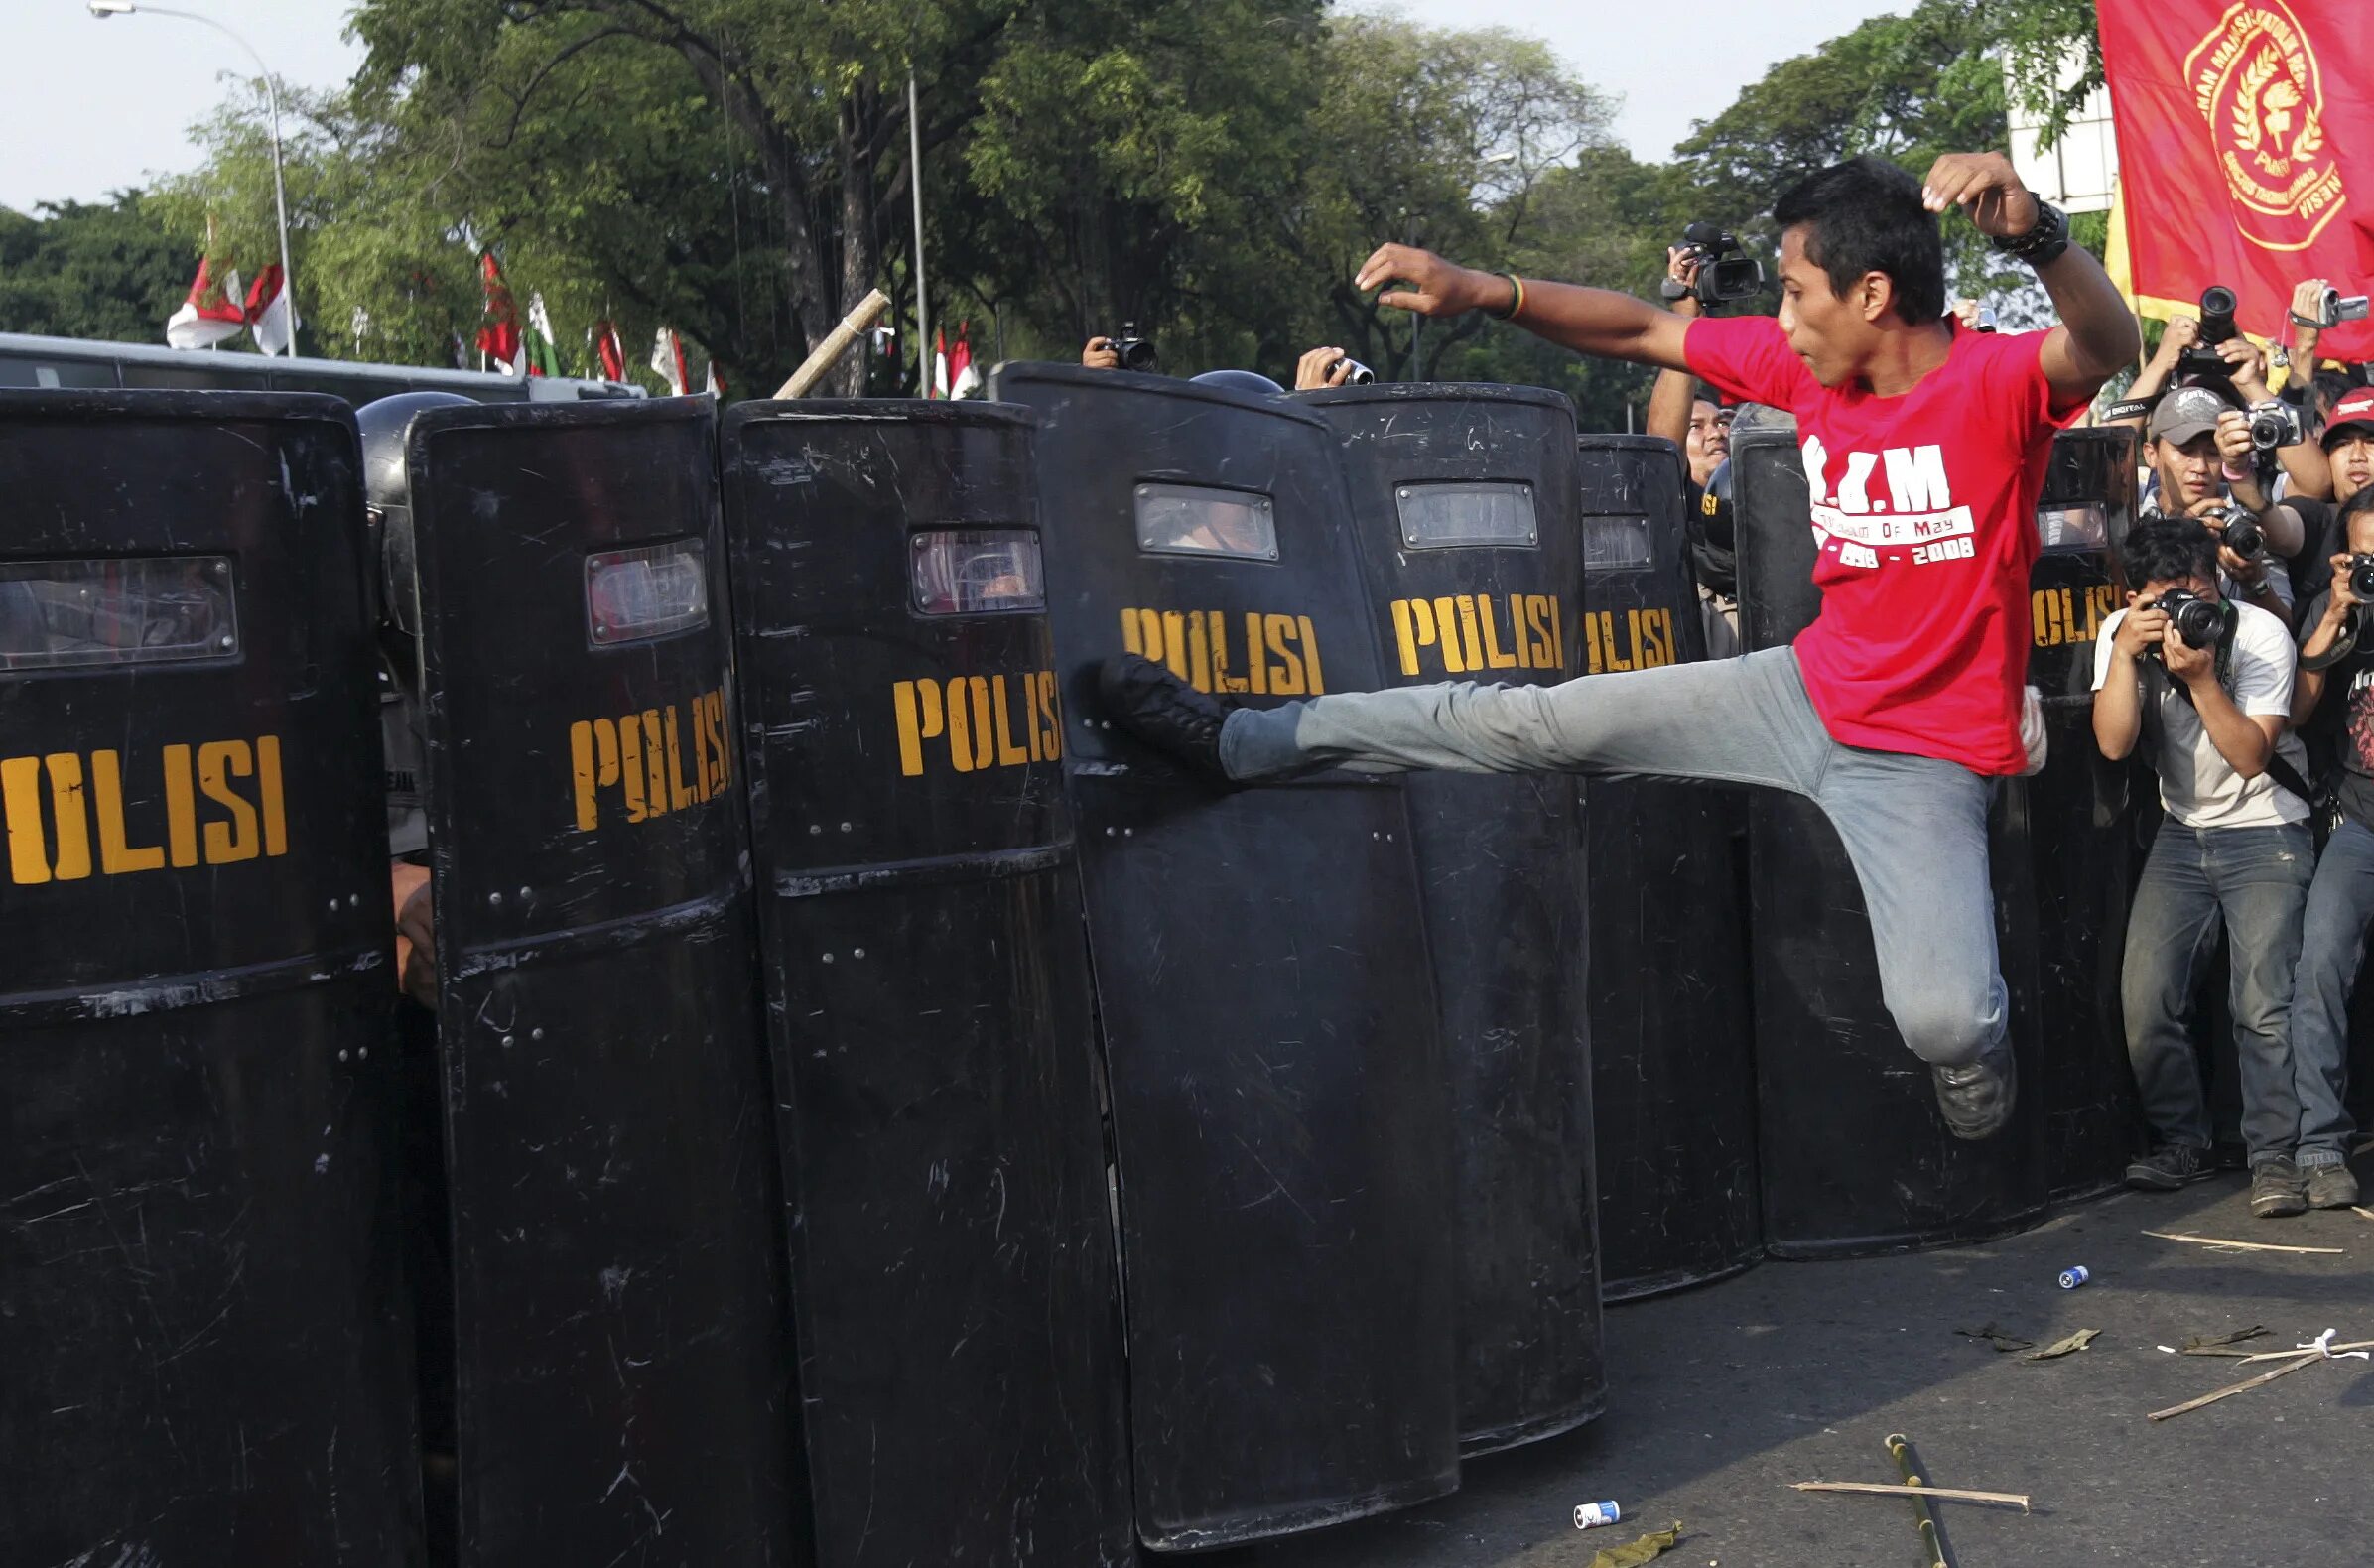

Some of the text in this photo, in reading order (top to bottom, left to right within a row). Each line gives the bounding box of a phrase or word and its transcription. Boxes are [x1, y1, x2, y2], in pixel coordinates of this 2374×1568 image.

[1912, 537, 1975, 565] 2008
[1913, 519, 1954, 538] May
[1391, 593, 1564, 676] POLISI
[571, 686, 733, 832] POLISI
[0, 735, 288, 885] OLISI
